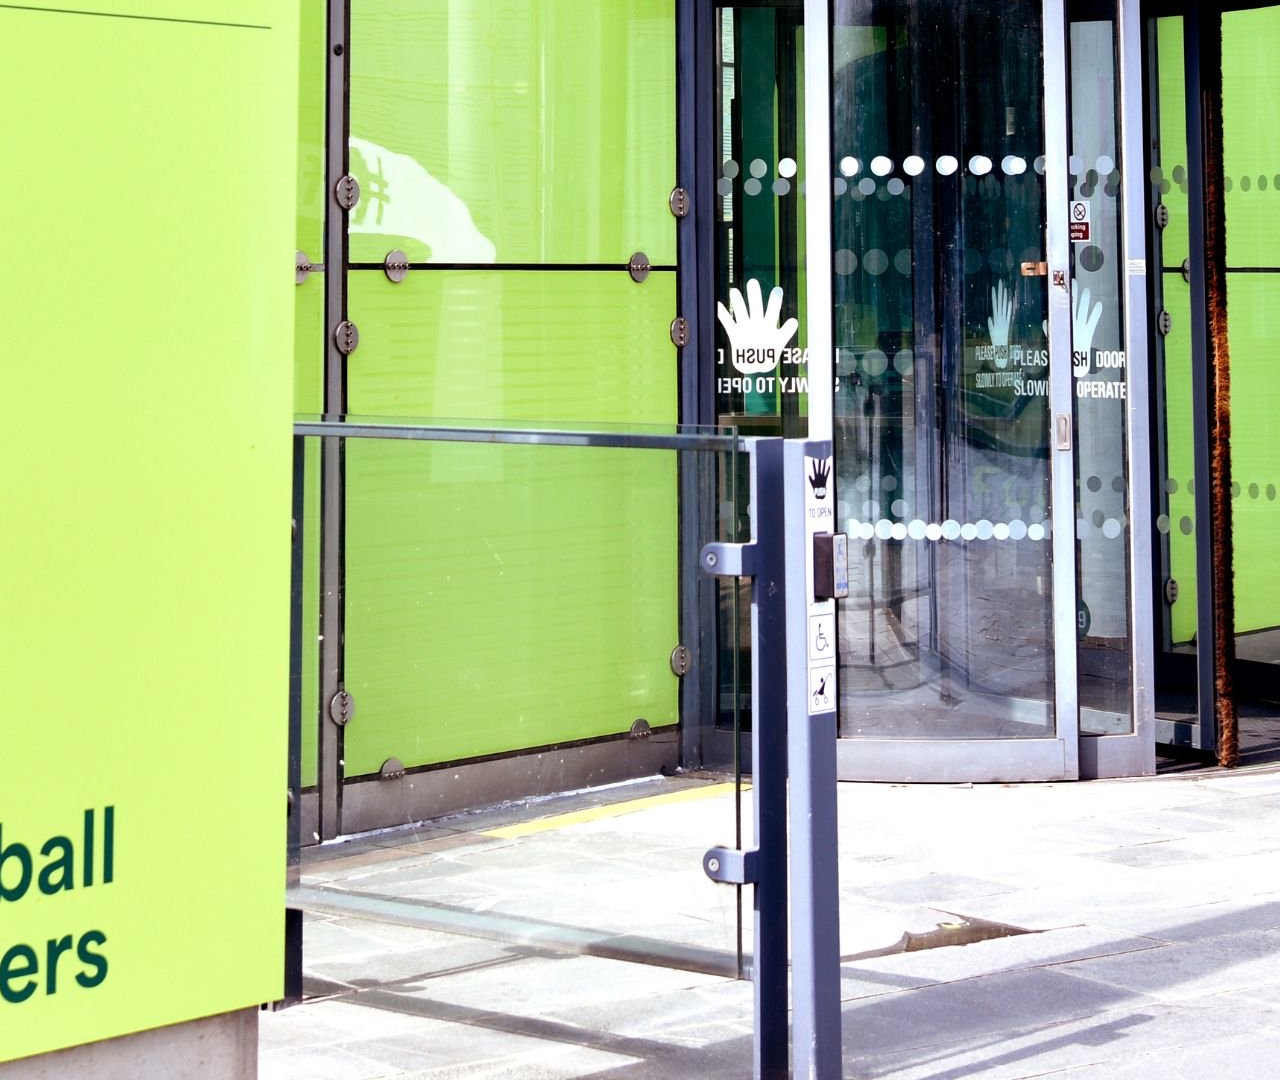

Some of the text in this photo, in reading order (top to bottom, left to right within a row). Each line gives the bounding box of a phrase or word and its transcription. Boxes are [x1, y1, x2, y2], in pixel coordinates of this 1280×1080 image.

[1013, 349, 1126, 368] PLEAS SH DOOR
[1014, 379, 1127, 399] SLOW OPERATE
[809, 506, 832, 519] TO OPEN
